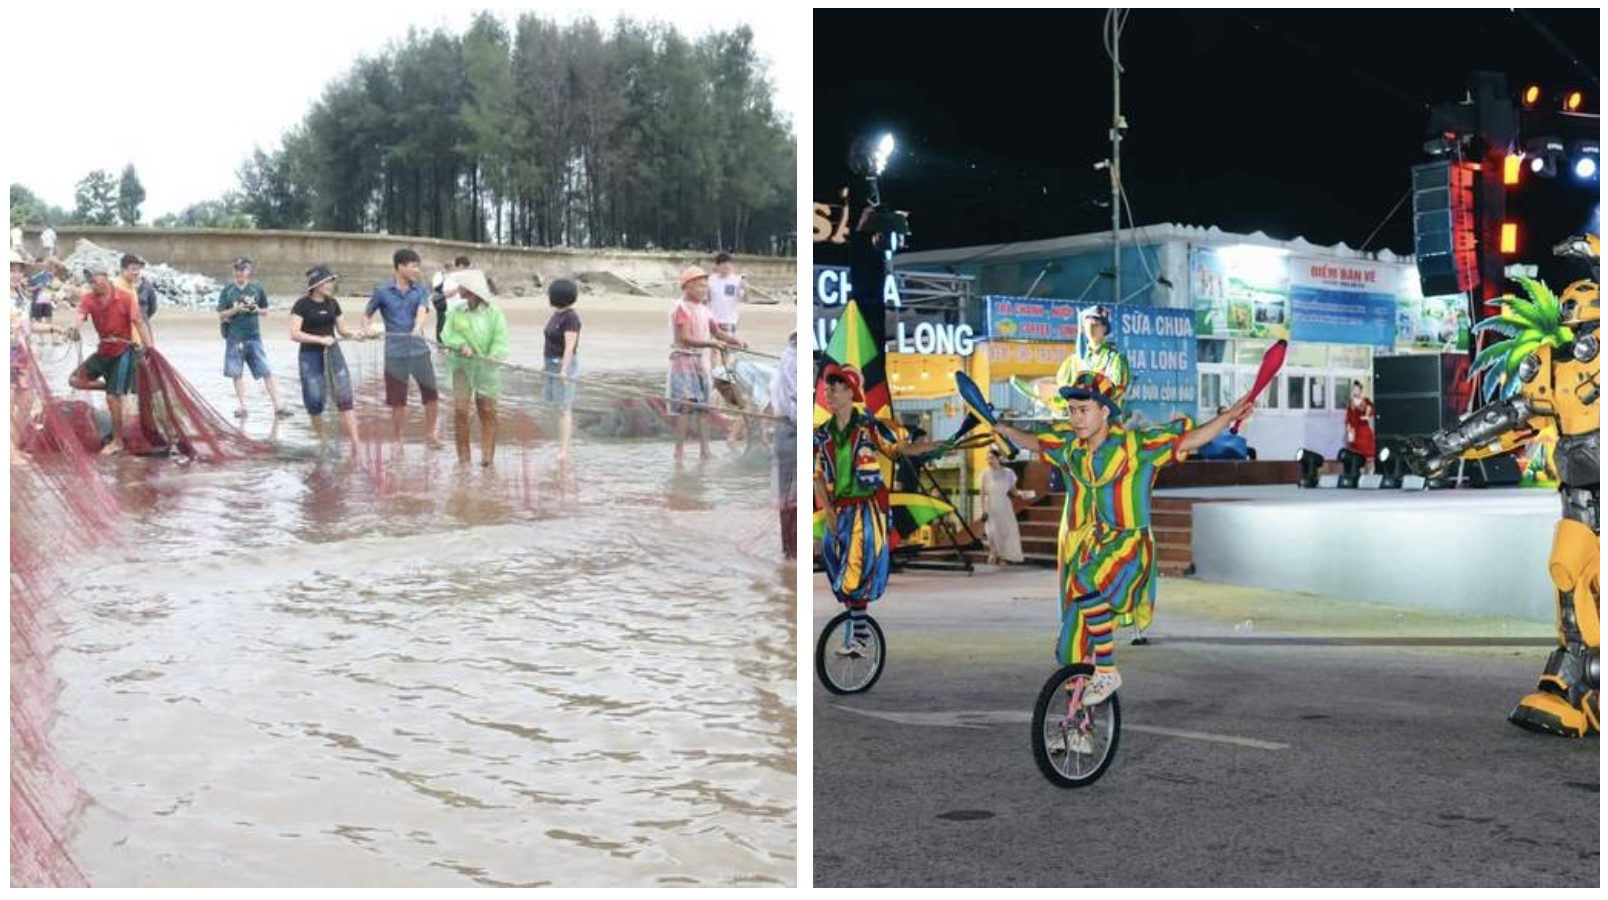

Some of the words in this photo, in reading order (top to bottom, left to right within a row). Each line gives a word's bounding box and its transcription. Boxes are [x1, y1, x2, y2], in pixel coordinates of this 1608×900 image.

[1155, 315, 1193, 338] CHUA
[897, 322, 973, 356] LONG
[1150, 350, 1188, 370] LONG
